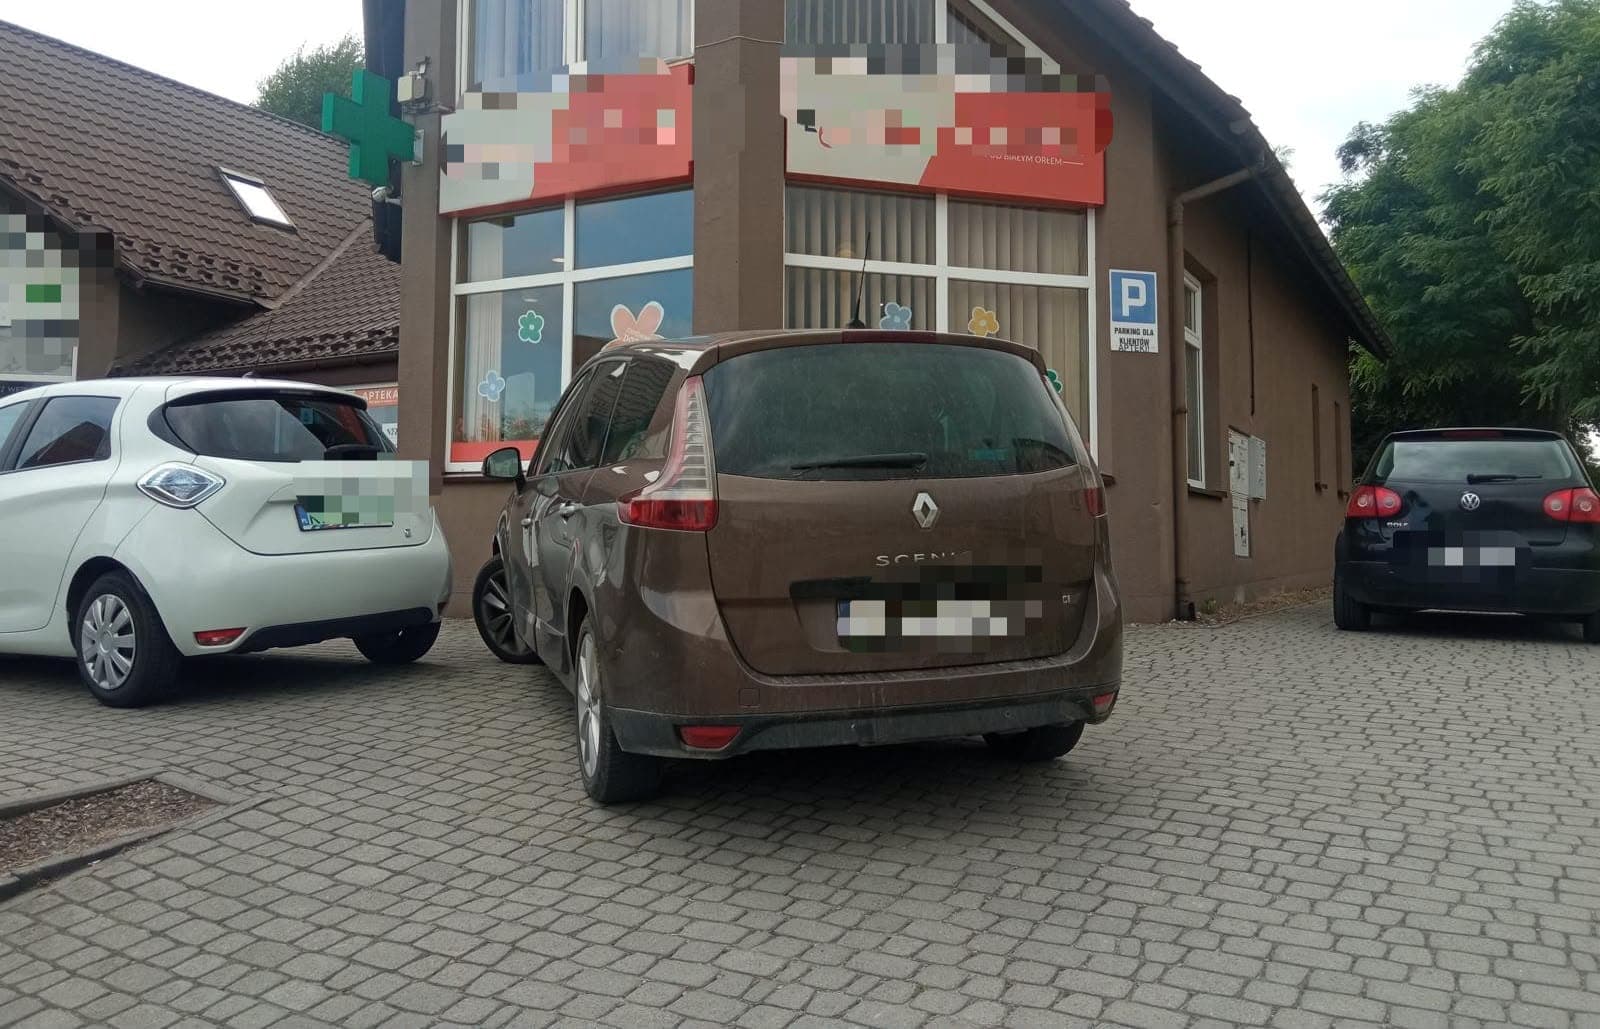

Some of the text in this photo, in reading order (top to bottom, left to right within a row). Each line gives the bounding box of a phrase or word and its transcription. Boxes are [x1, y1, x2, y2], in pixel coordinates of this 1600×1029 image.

[1034, 156, 1062, 165] ORŁEM
[1121, 278, 1147, 317] P
[1114, 327, 1154, 336] PARKING DLA
[363, 389, 398, 401] APTEKA
